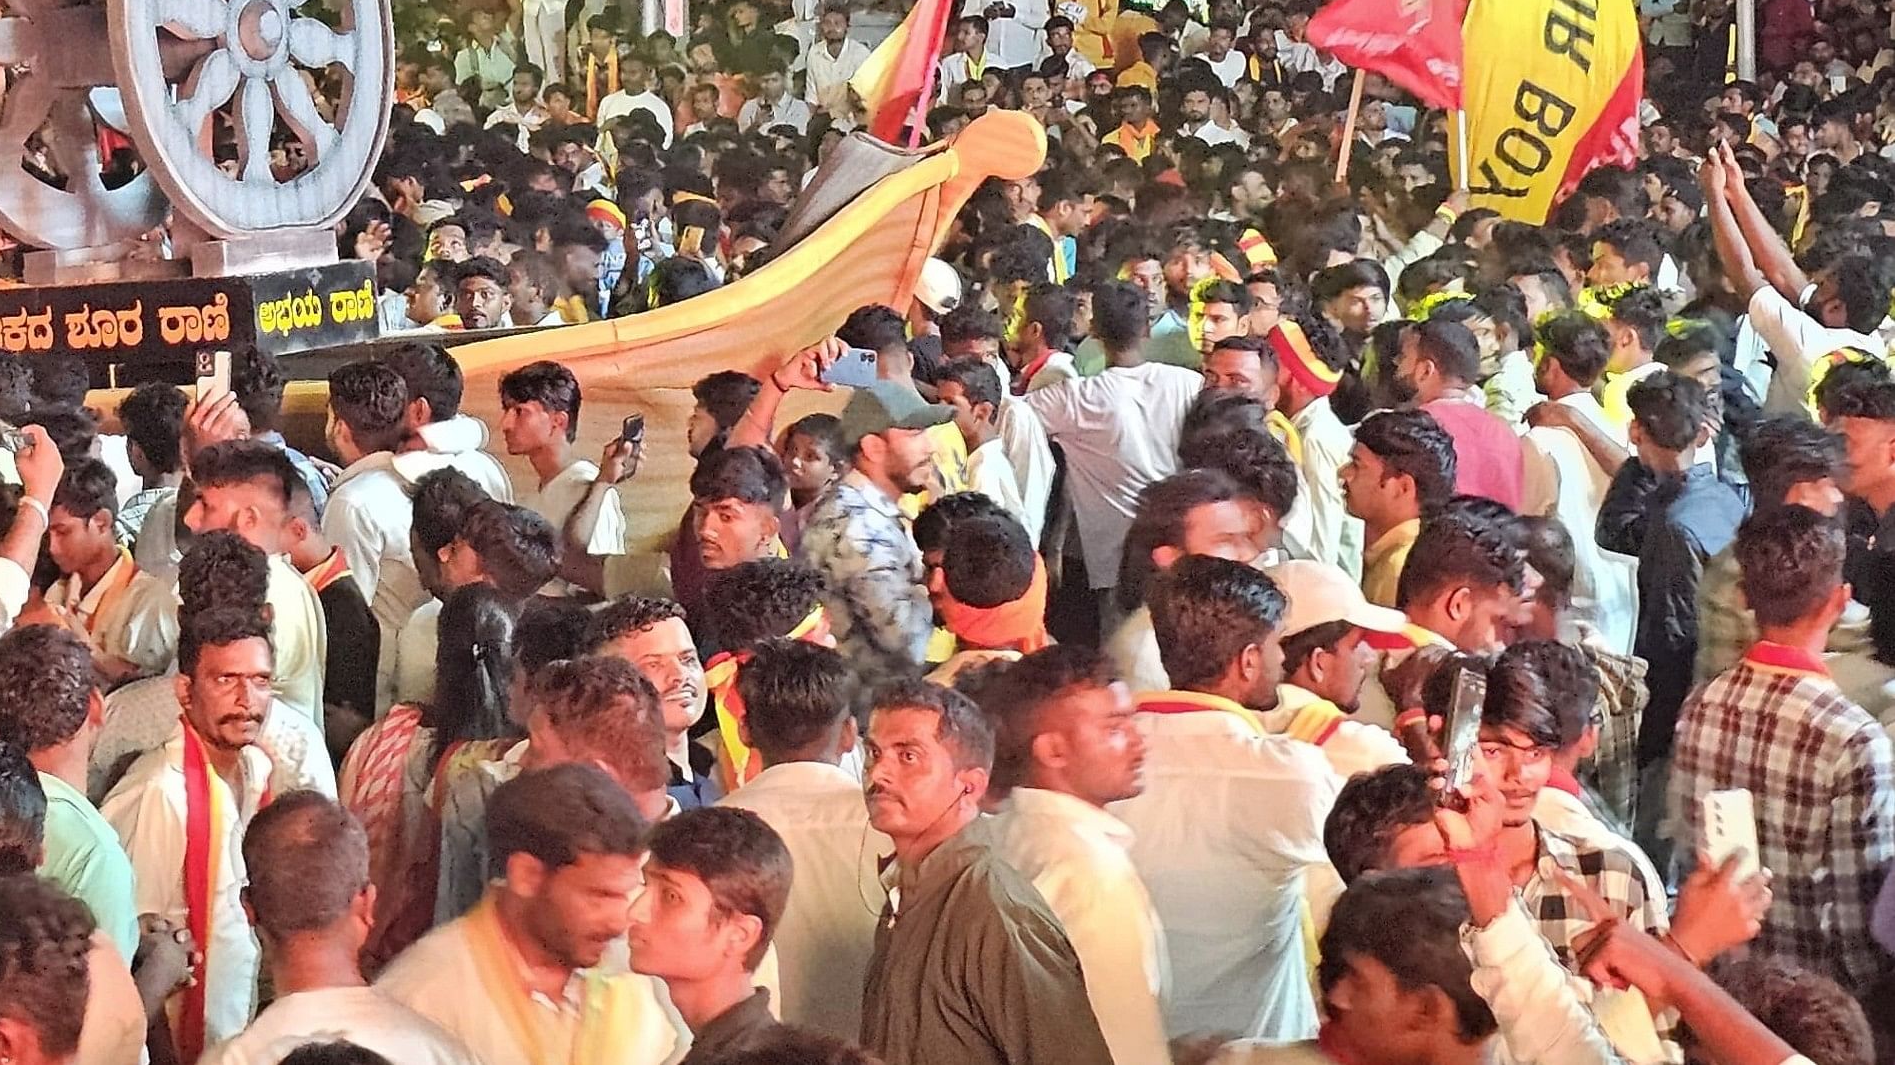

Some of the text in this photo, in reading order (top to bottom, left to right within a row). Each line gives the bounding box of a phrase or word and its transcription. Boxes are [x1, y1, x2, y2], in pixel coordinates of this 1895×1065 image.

[65, 299, 143, 349] ಶೂರ
[159, 291, 230, 344] ರಾಣಿ
[259, 278, 375, 337] ಅಭಯ ರಾಣಿ
